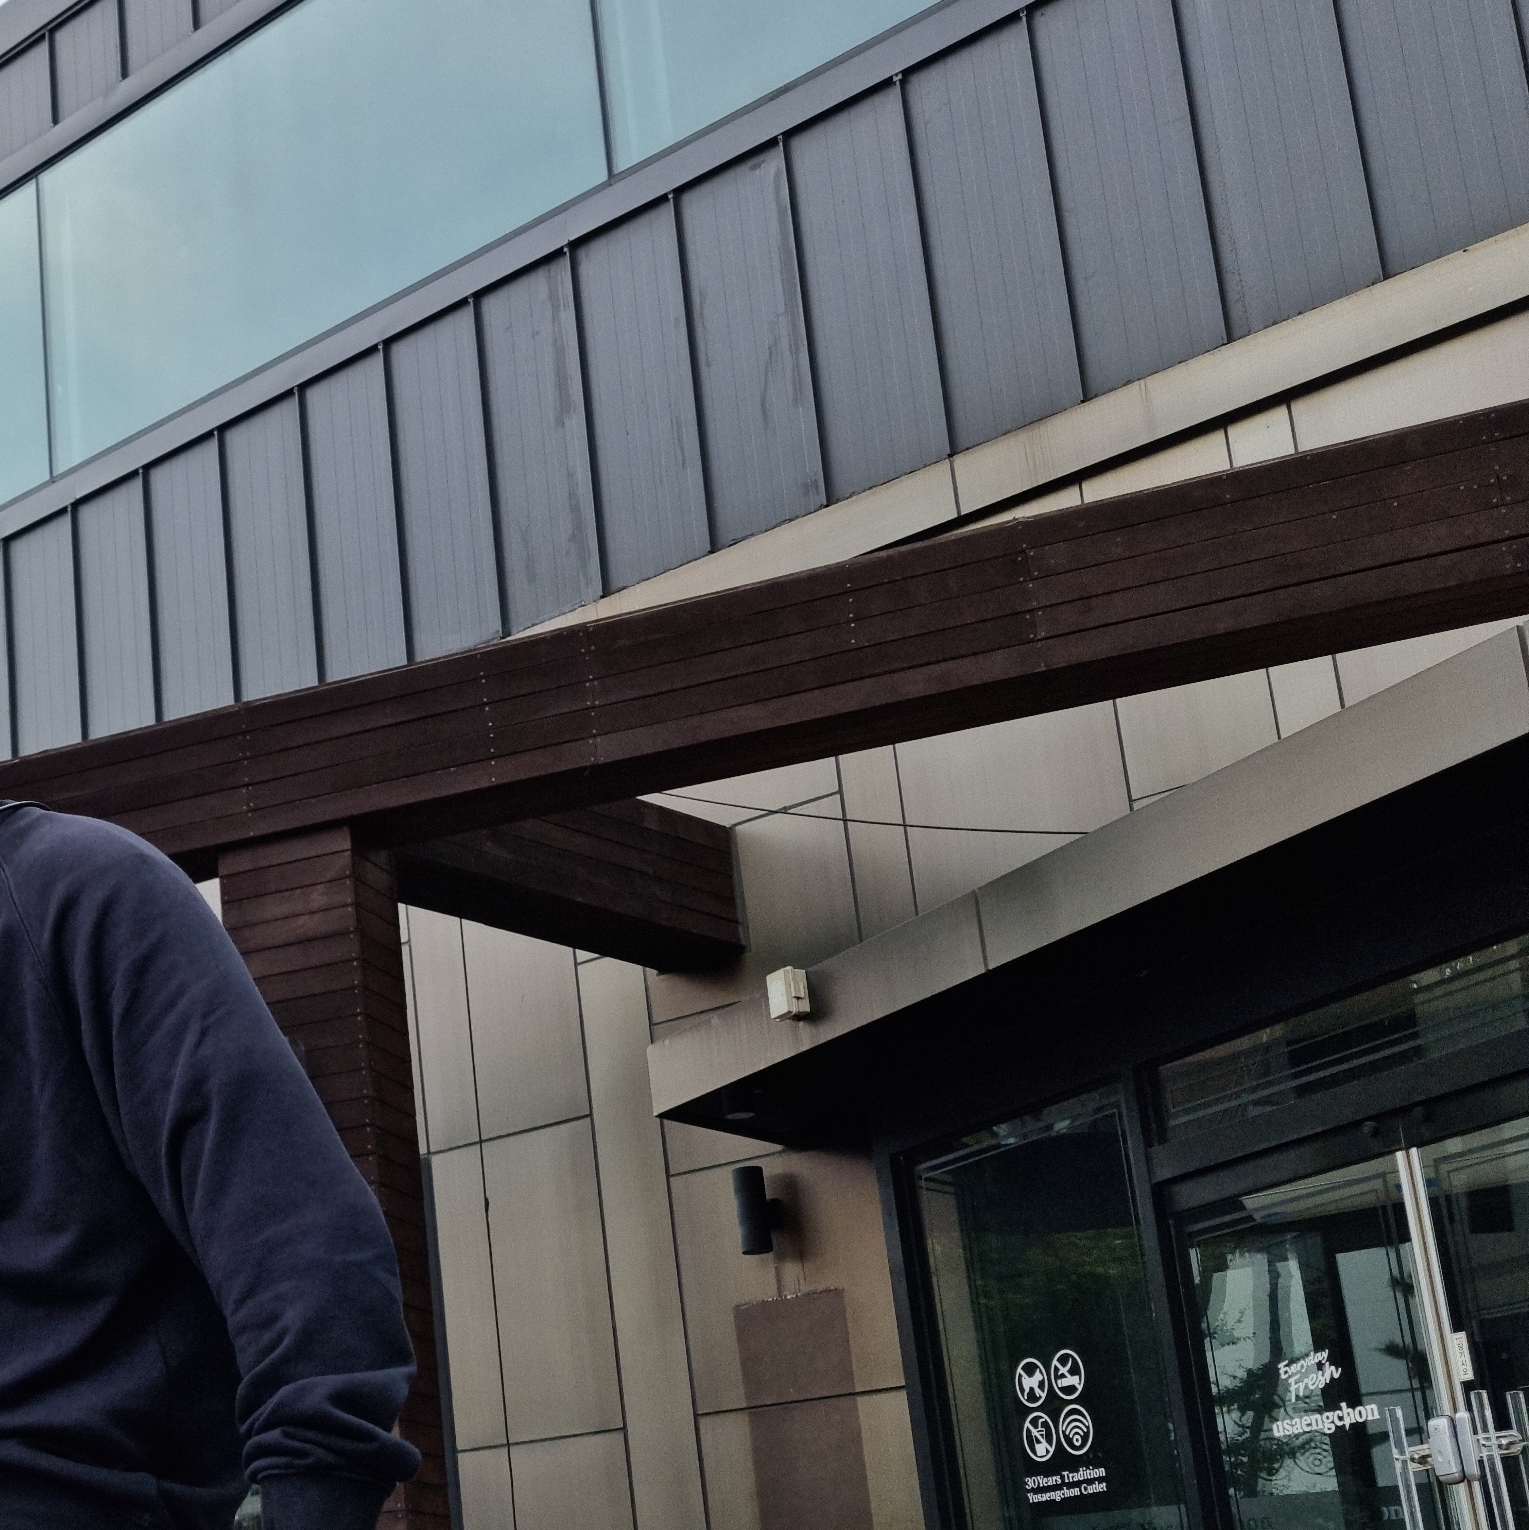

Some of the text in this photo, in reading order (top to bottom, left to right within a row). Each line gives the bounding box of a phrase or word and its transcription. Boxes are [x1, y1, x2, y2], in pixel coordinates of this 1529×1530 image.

[1278, 1349, 1328, 1379] Everyday
[1288, 1362, 1342, 1402] Fresh
[1025, 1466, 1106, 1490] 30Years Tradition
[1027, 1481, 1107, 1504] Yusaengchon Cutlet
